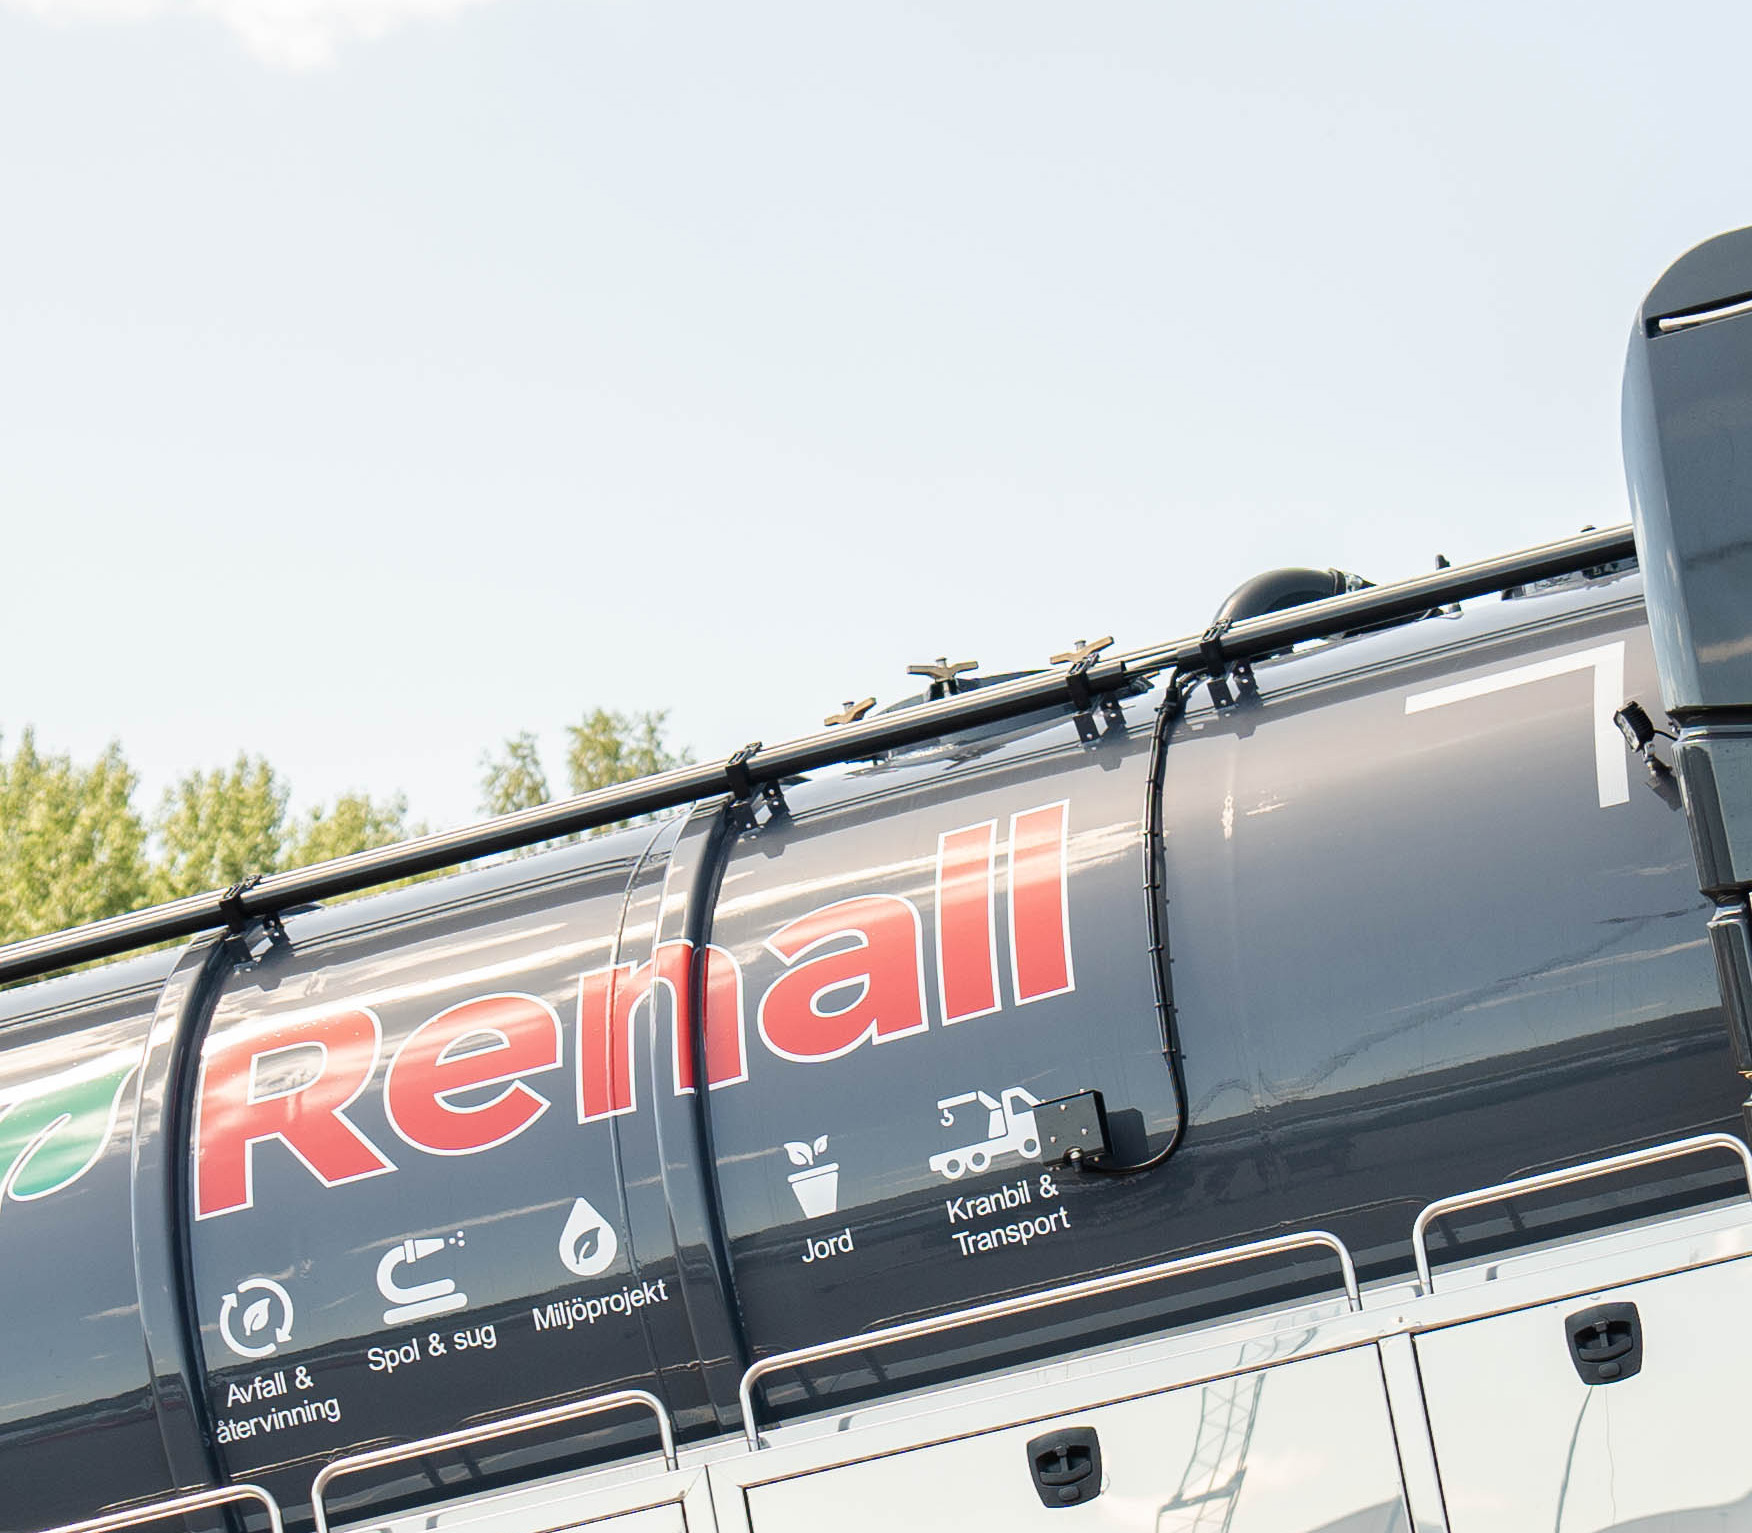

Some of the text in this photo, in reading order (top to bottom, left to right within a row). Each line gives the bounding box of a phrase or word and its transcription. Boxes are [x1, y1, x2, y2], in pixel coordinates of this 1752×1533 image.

[194, 798, 1076, 1220] Renall
[945, 1174, 1060, 1224] Kranbil &
[801, 1227, 854, 1265] Jord
[951, 1205, 1072, 1256] Transport
[532, 1278, 669, 1331] Miljöprojekt
[367, 1323, 498, 1374] Spol & sug
[226, 1365, 315, 1408] Avfall &
[216, 1396, 341, 1444] återvinning
